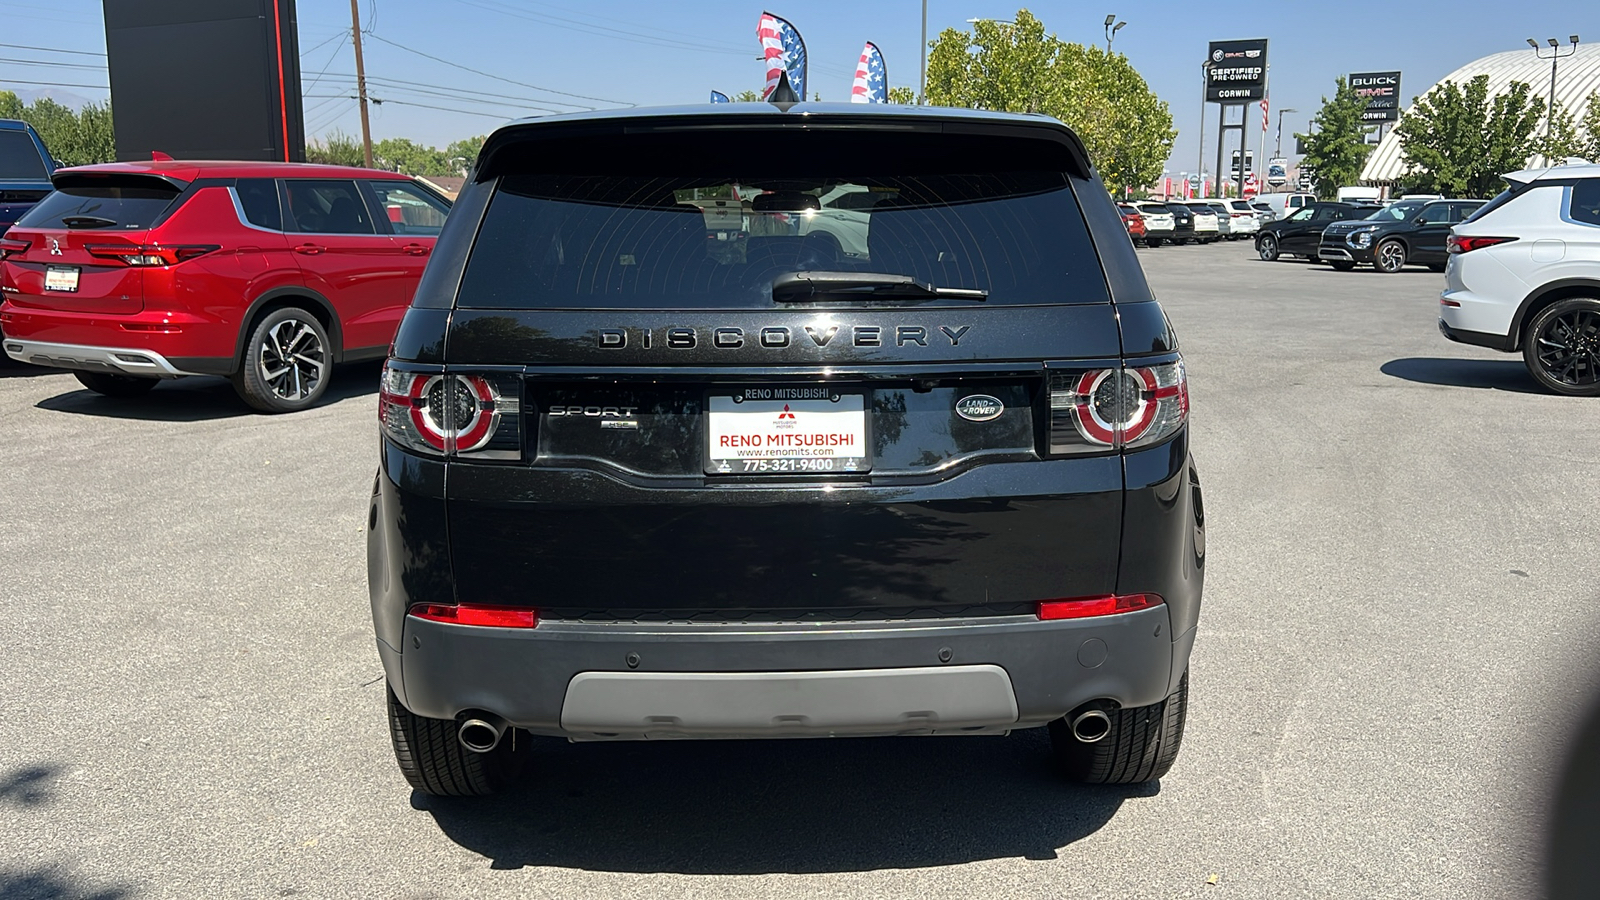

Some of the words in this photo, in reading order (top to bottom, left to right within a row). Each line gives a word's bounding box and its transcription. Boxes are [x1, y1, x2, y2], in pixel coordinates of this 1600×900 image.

[1210, 67, 1262, 75] CERTIFIED
[1353, 76, 1396, 85] BUICK
[1218, 89, 1251, 98] CORWIN
[1360, 112, 1387, 120] ORWIN
[598, 325, 971, 350] DISCOVERY
[745, 388, 772, 399] RENO
[774, 388, 829, 399] MITSUBISHI
[549, 405, 639, 418] SPORT
[720, 434, 762, 447] RENO
[767, 433, 854, 447] MITSUBISHI
[737, 447, 834, 457] www.renomits.com
[742, 458, 834, 471] 775-321-9400
